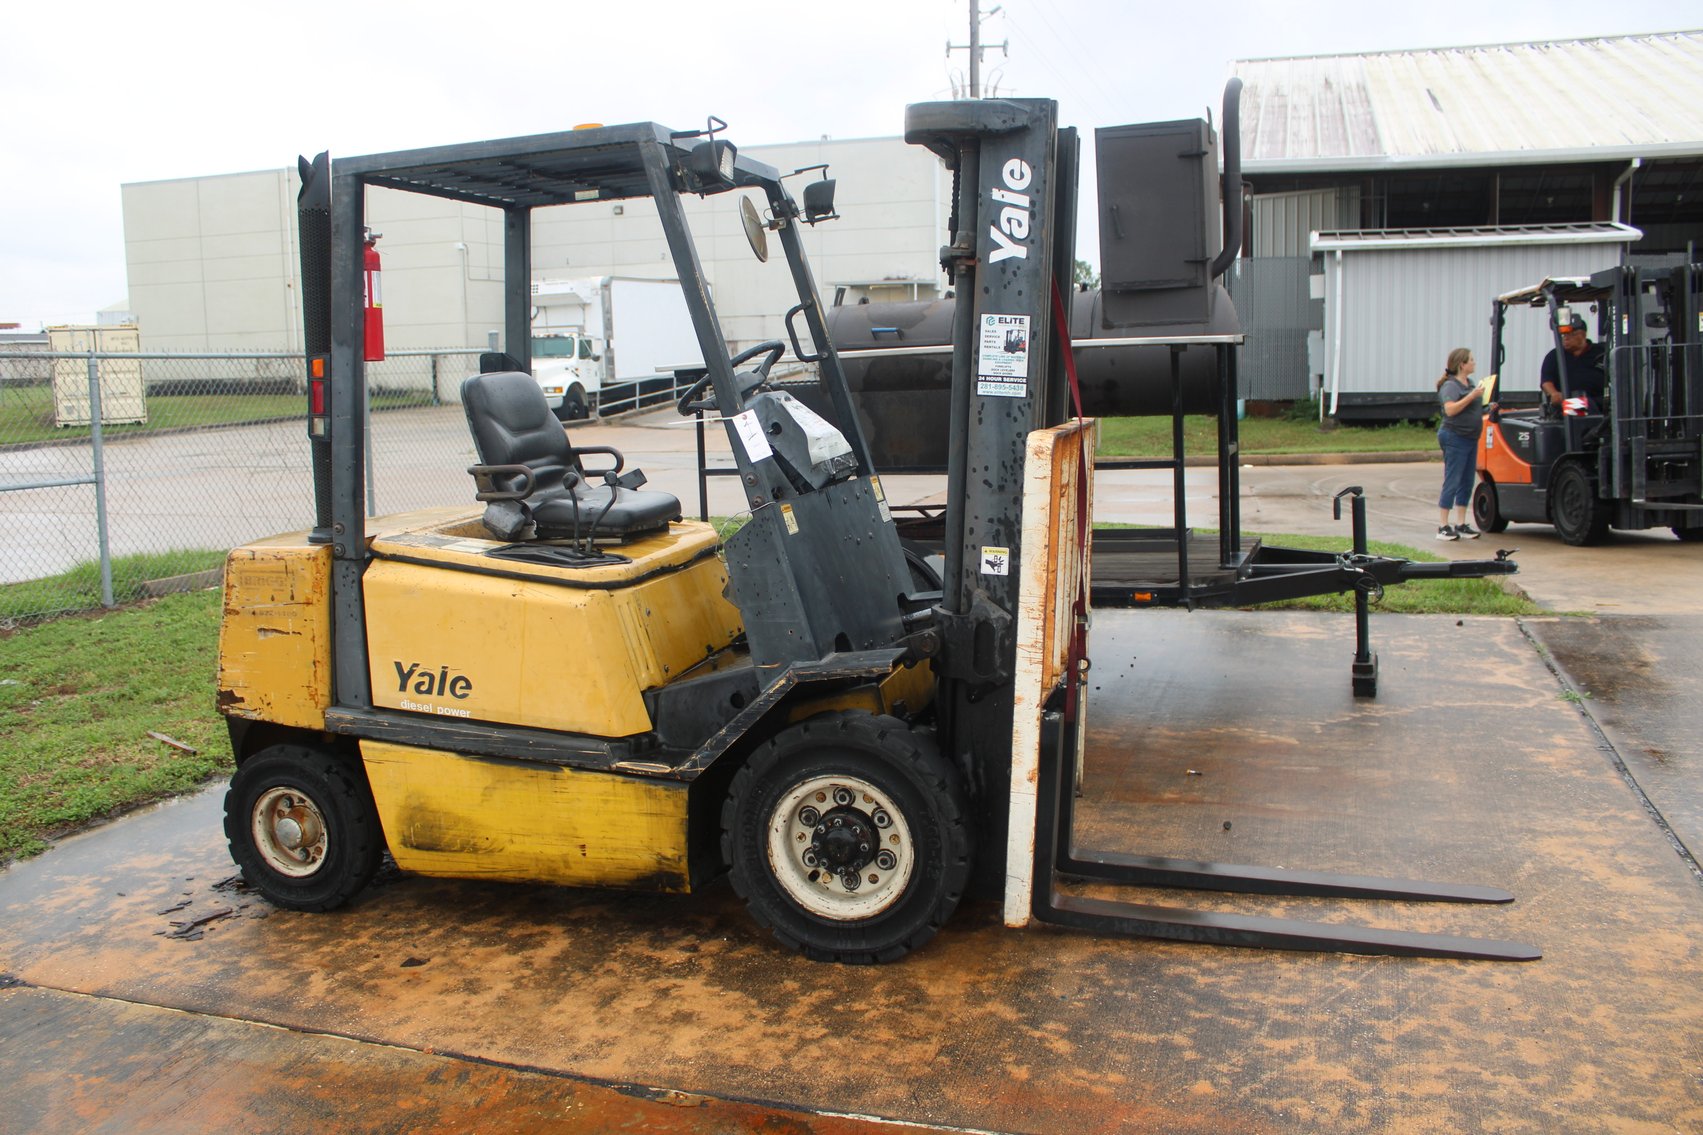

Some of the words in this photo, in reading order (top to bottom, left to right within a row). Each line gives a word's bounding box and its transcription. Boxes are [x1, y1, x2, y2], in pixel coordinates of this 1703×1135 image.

[988, 158, 1032, 264] Yale
[998, 317, 1025, 325] ELITE
[1518, 431, 1530, 441] 25
[393, 661, 473, 700] Yale
[400, 699, 433, 713] diesel
[437, 706, 472, 718] power
